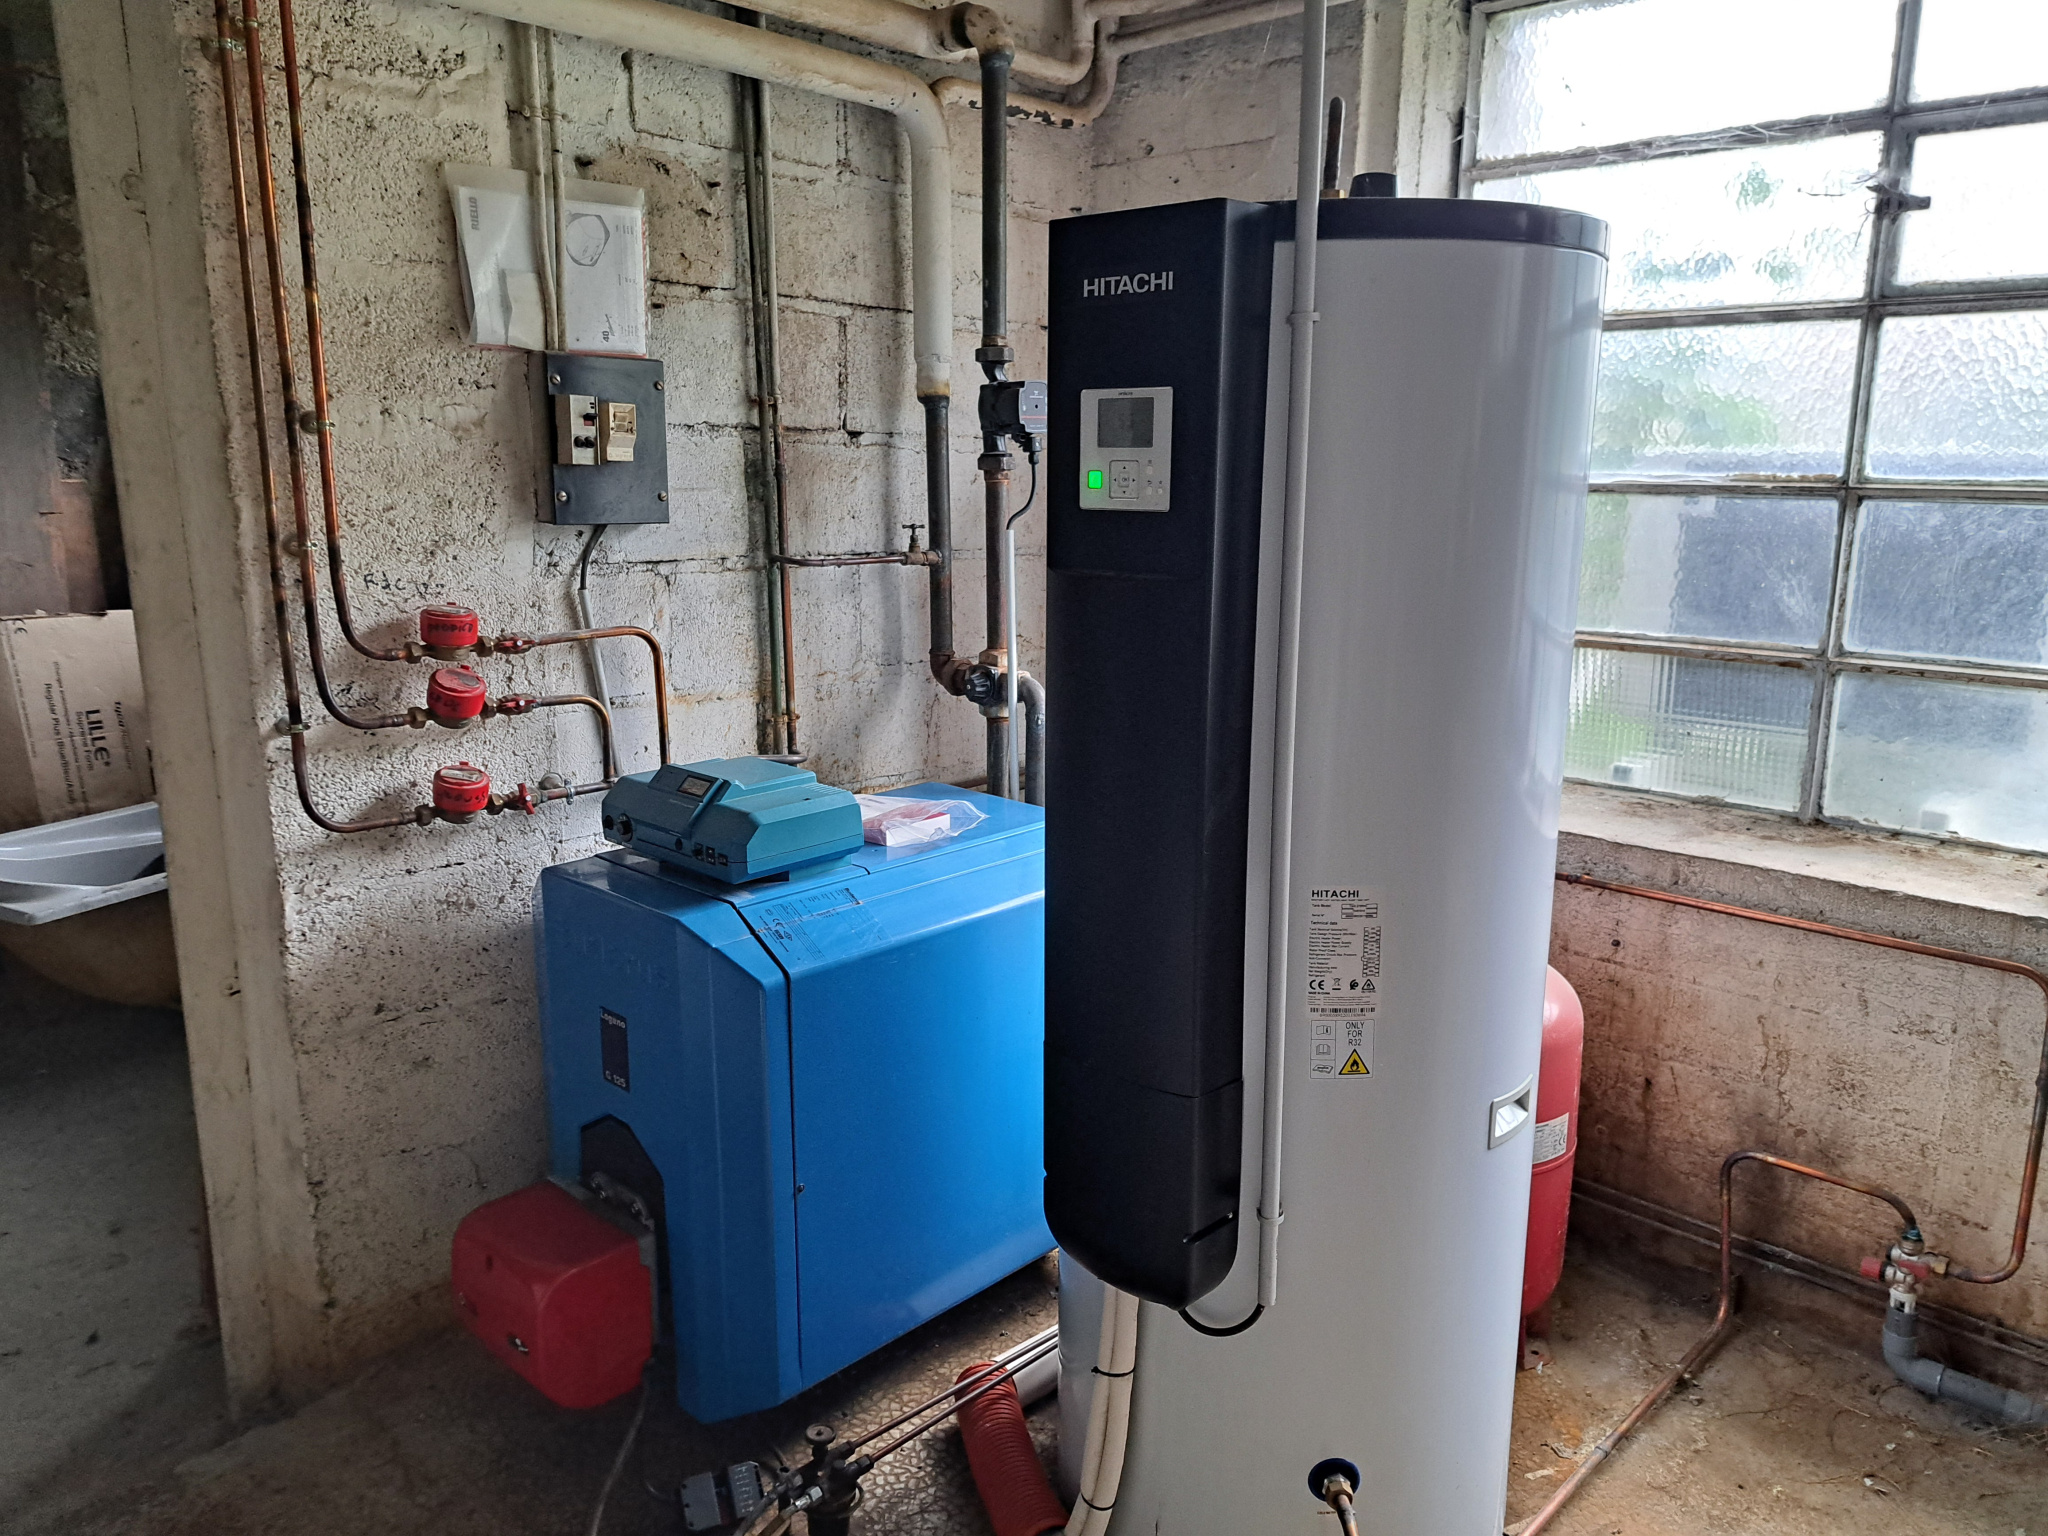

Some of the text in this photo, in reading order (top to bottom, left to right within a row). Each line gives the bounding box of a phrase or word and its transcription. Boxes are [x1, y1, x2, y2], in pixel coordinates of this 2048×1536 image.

[469, 196, 481, 231] RIELLO
[1083, 271, 1174, 298] HITACHI
[602, 330, 611, 344] 40
[1311, 889, 1360, 898] HITACHI
[1345, 1021, 1365, 1030] ONLY
[1347, 1030, 1363, 1038] FOR
[1348, 1038, 1362, 1047] R32
